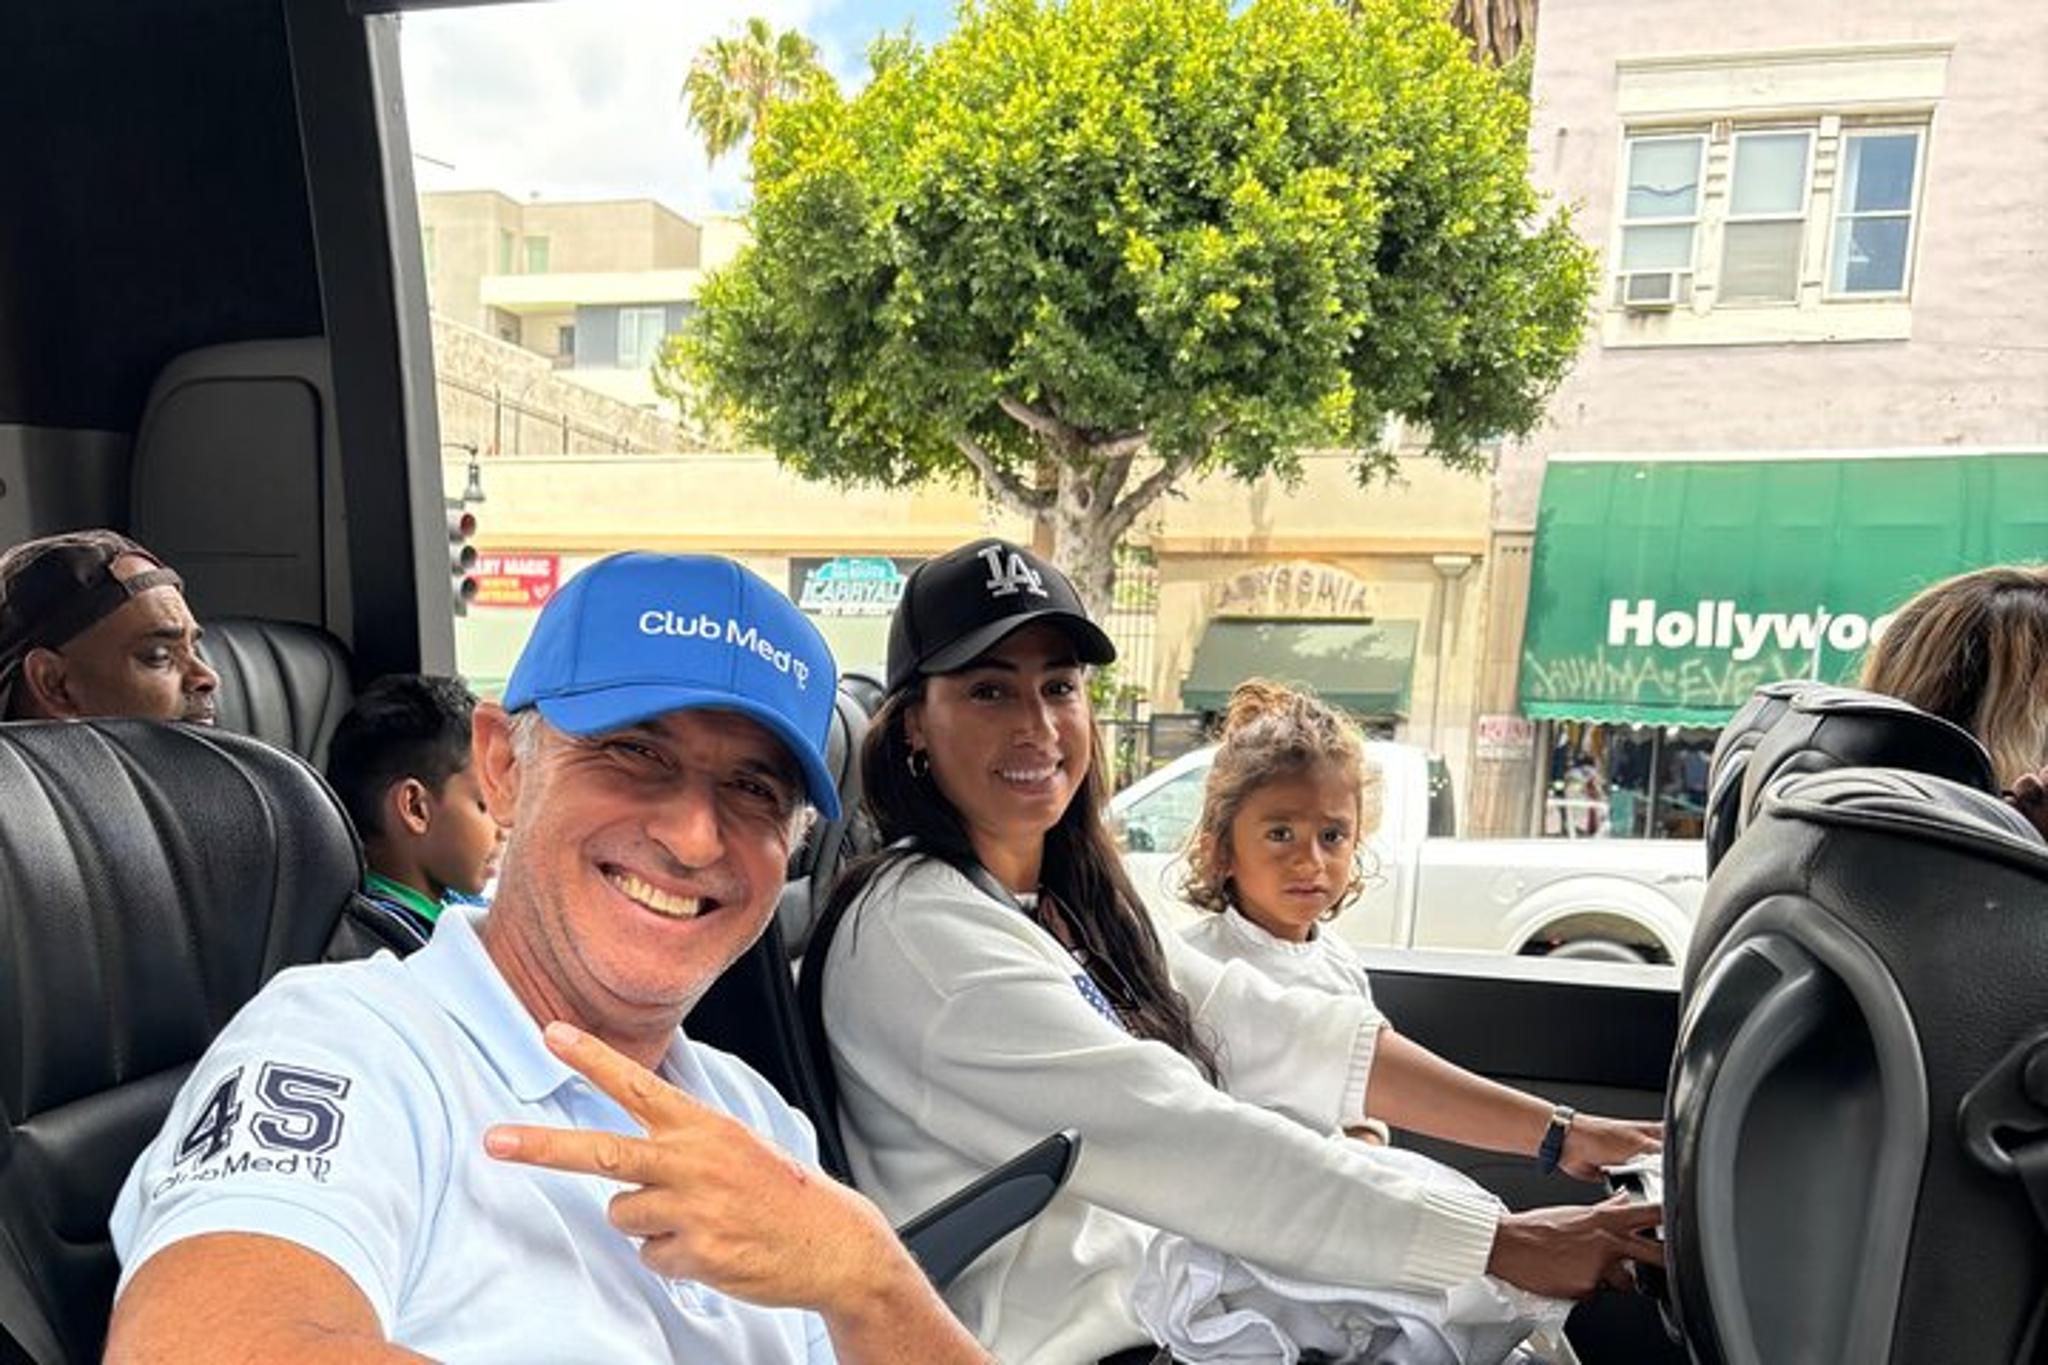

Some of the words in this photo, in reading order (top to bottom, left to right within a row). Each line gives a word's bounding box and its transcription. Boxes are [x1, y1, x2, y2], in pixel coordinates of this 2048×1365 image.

[977, 545, 1048, 598] LA
[638, 610, 721, 640] Club
[726, 619, 793, 673] Med
[173, 1061, 351, 1167] 45
[221, 1150, 298, 1179] Med
